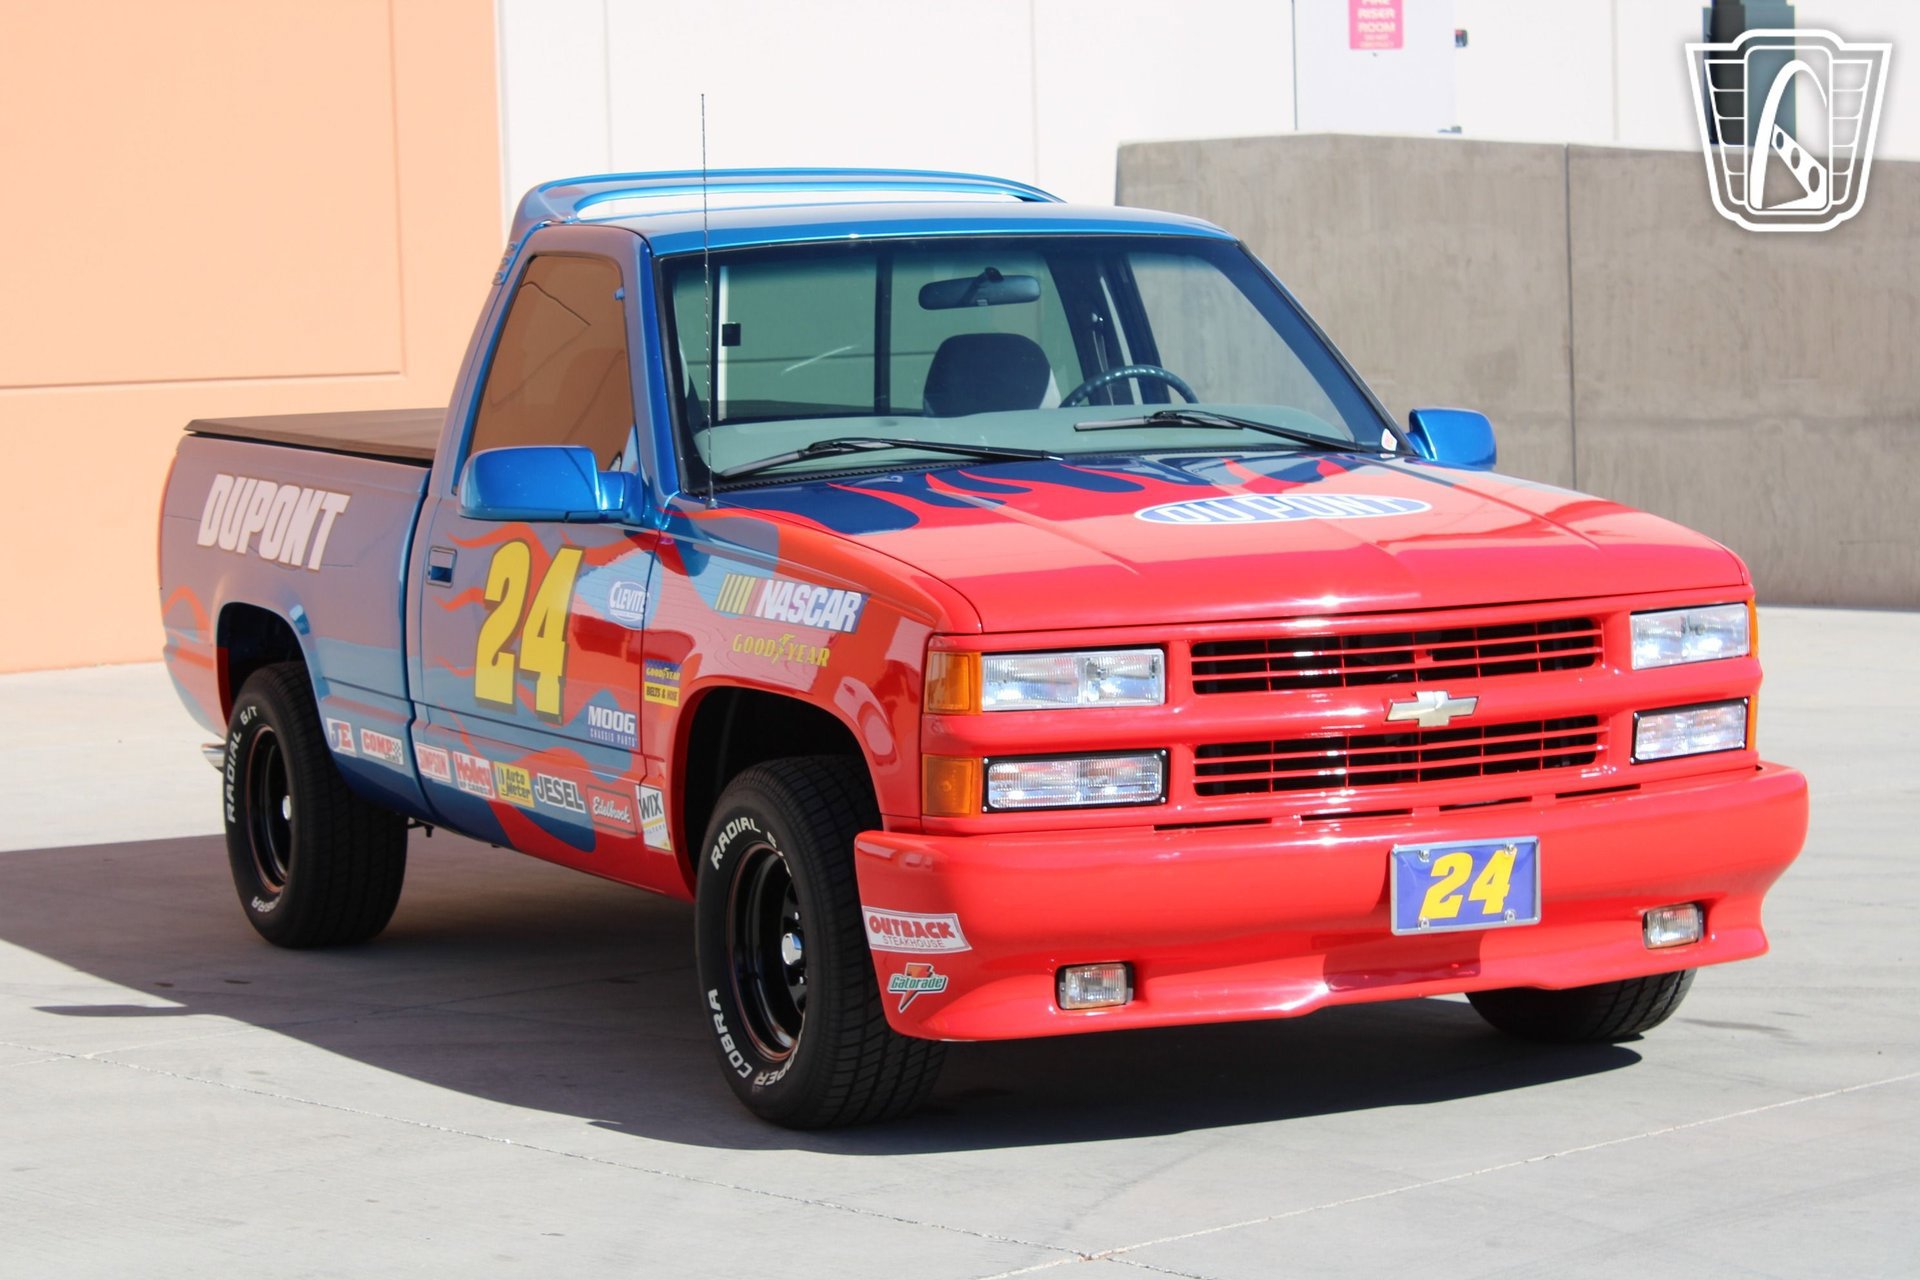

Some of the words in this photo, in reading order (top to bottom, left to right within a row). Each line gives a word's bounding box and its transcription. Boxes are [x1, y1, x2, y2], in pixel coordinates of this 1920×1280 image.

[1358, 22, 1396, 33] ROOM
[197, 473, 351, 571] DUPONT
[754, 579, 863, 633] NASCAR
[475, 540, 584, 717] 24
[588, 705, 636, 735] MOOG
[617, 734, 636, 748] PARTS
[226, 731, 242, 823] RADIAL
[535, 773, 585, 812] JESEL
[638, 792, 663, 820] WIX
[710, 817, 761, 870] RADIAL
[1418, 847, 1517, 920] 24
[868, 915, 956, 939] OUTBACK
[882, 936, 945, 948] STEAKHOUSE
[891, 975, 943, 989] Gatorade
[708, 989, 752, 1079] COBRA
